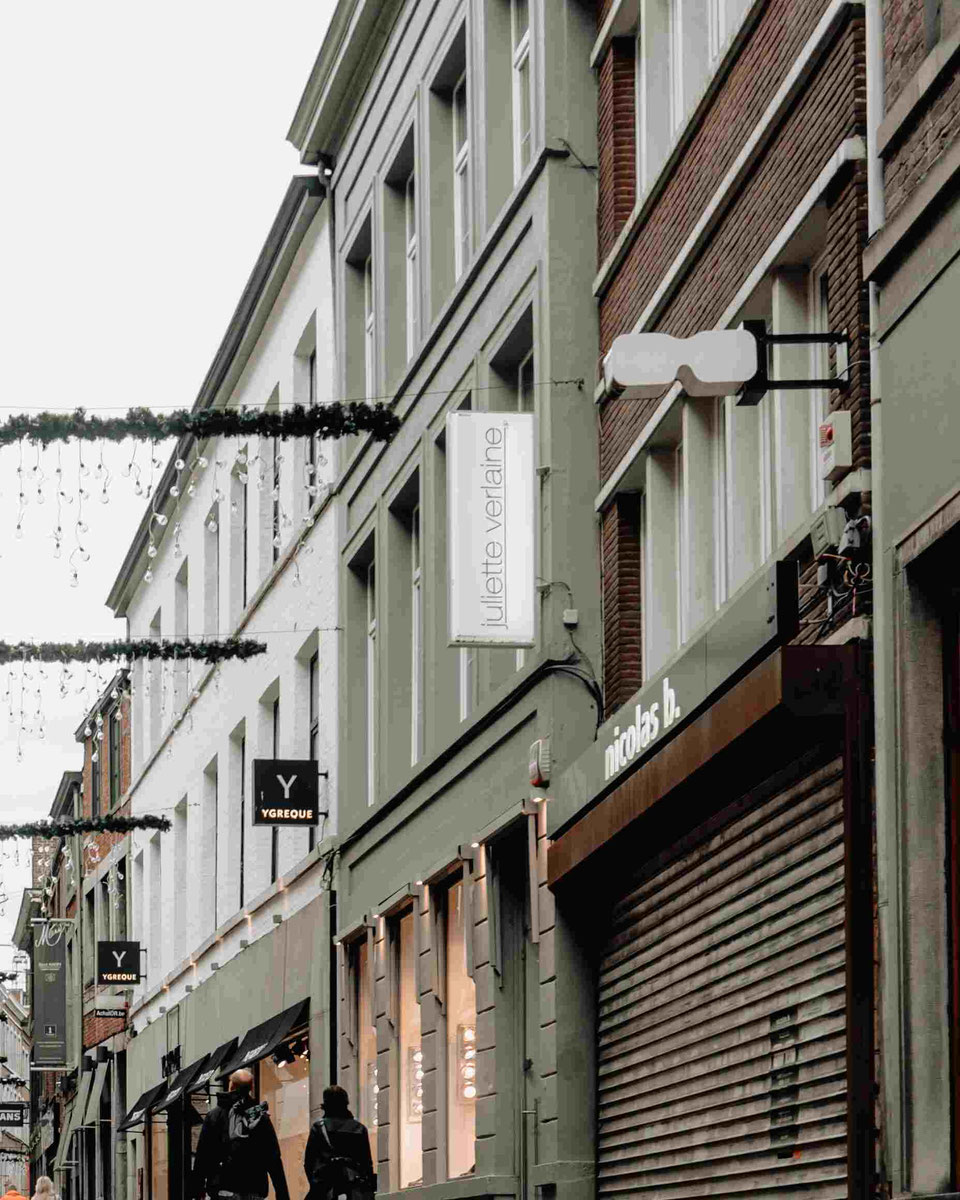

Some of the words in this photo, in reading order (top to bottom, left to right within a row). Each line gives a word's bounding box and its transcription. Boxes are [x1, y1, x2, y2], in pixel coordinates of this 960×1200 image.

[480, 427, 503, 532] verlaine
[480, 540, 508, 629] juliette
[605, 702, 659, 780] nicolas
[663, 677, 680, 728] b.
[276, 774, 298, 799] Y
[261, 808, 313, 819] YGREQUE
[112, 950, 127, 968] Y
[102, 973, 137, 981] YGREQUE
